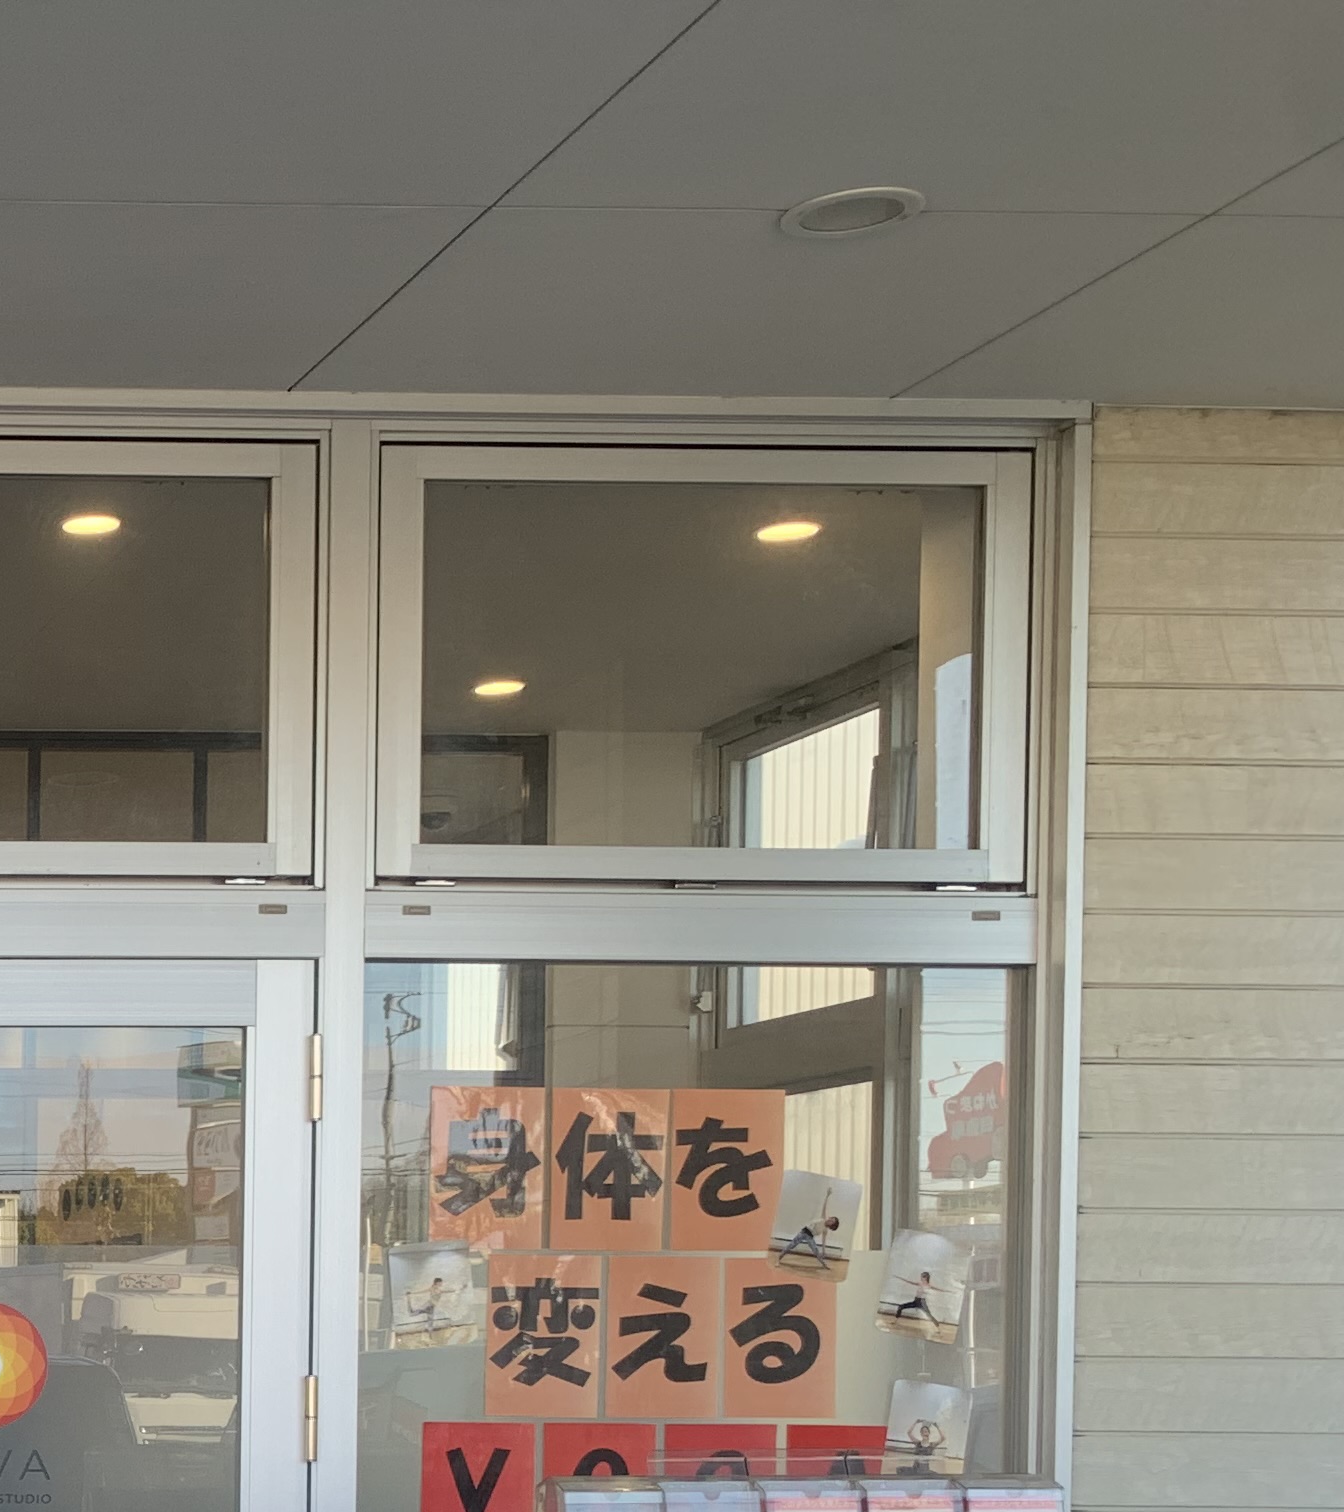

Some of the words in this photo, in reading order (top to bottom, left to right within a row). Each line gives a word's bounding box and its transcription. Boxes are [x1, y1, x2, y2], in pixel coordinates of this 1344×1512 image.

[436, 1107, 774, 1220] 身体を
[489, 1276, 822, 1388] 変える
